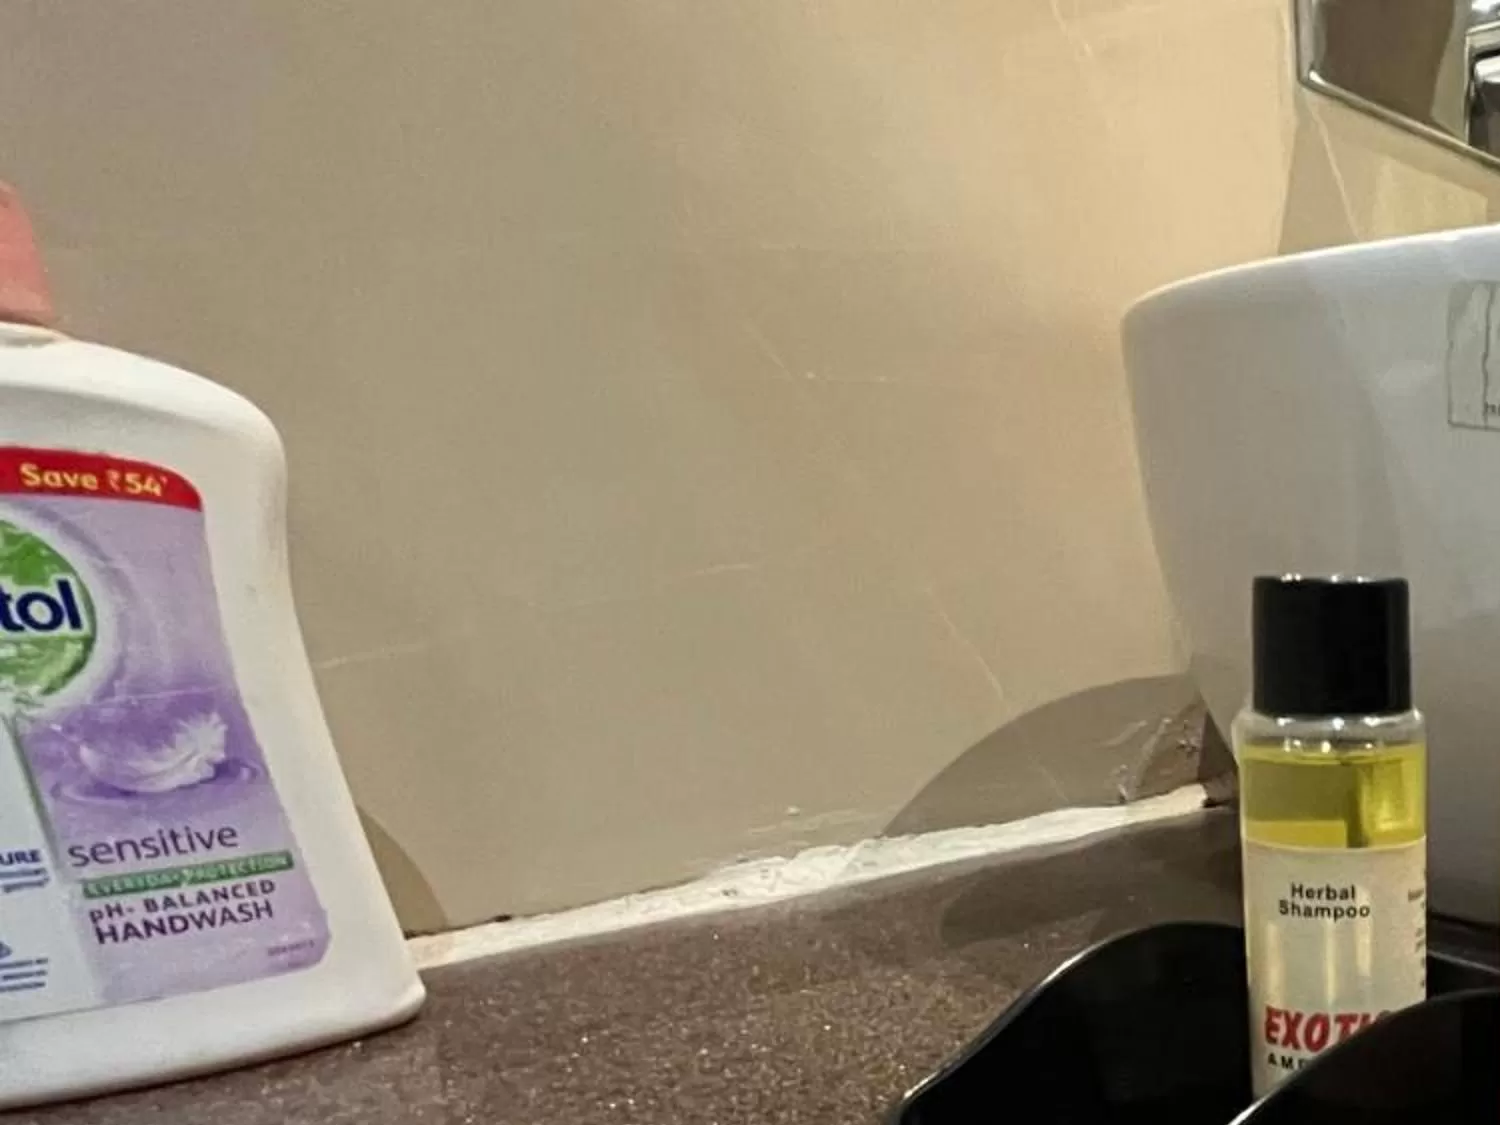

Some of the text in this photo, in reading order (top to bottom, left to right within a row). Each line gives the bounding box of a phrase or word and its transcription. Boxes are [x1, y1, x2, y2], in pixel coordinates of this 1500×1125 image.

[20, 462, 100, 490] Save
[68, 825, 239, 868] sensitive
[144, 879, 276, 912] BALANCED
[1291, 882, 1357, 902] Herbal
[94, 899, 274, 946] HANDWASH
[1279, 899, 1371, 923] Shampoo
[1264, 1006, 1371, 1053] EXOT
